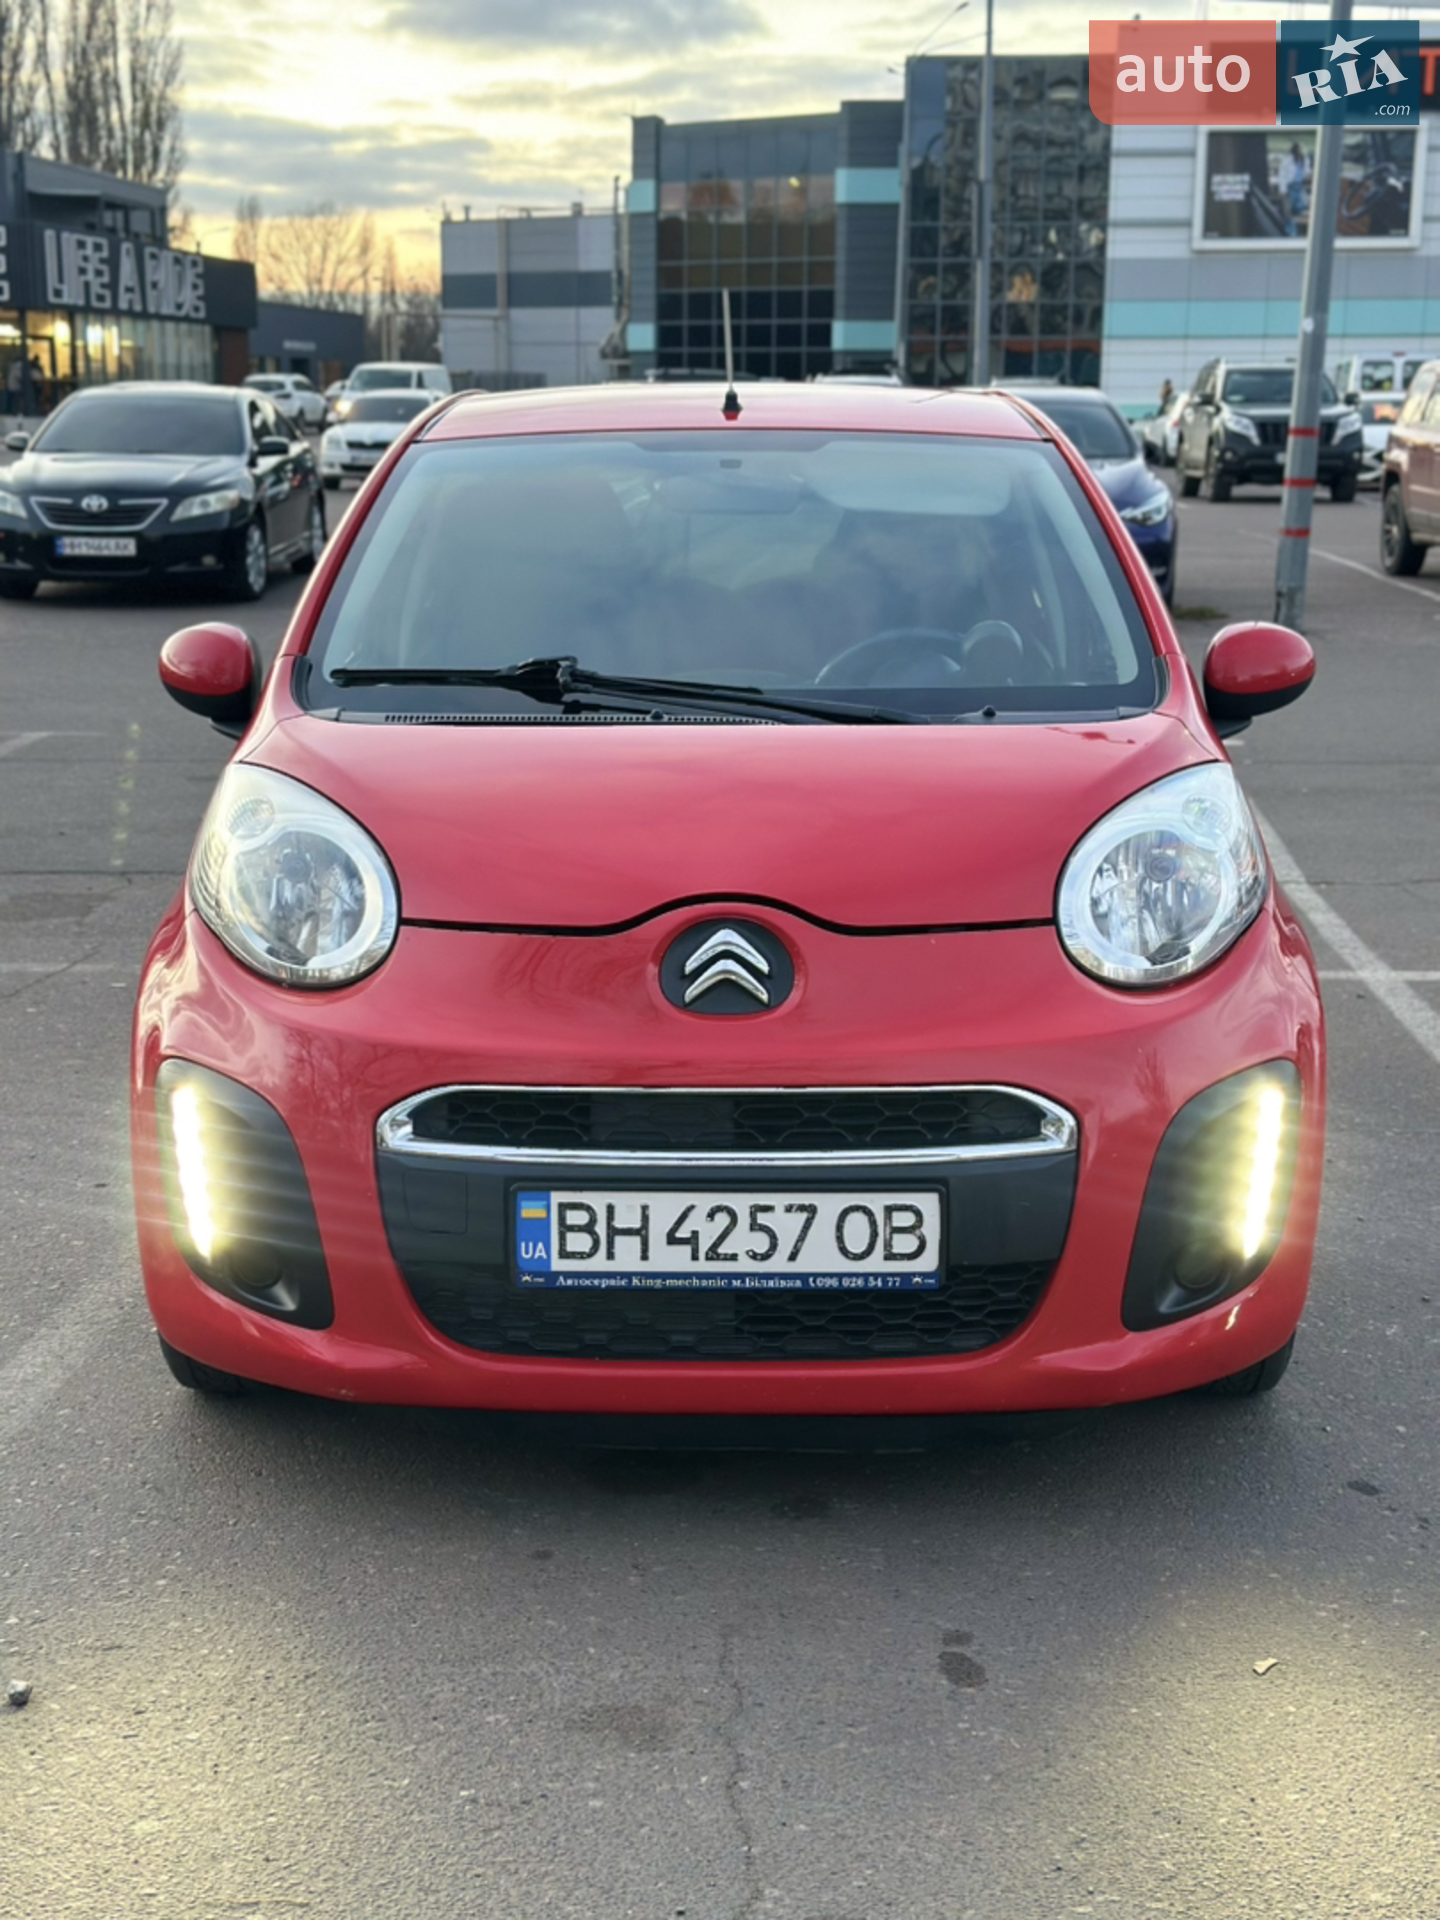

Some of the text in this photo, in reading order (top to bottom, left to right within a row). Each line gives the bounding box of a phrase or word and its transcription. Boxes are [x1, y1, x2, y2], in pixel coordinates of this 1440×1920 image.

[43, 229, 112, 310] LIFE
[117, 241, 144, 313] A
[143, 245, 207, 320] RIDE
[520, 1241, 548, 1259] UA
[557, 1201, 928, 1263] BH 4257 OB
